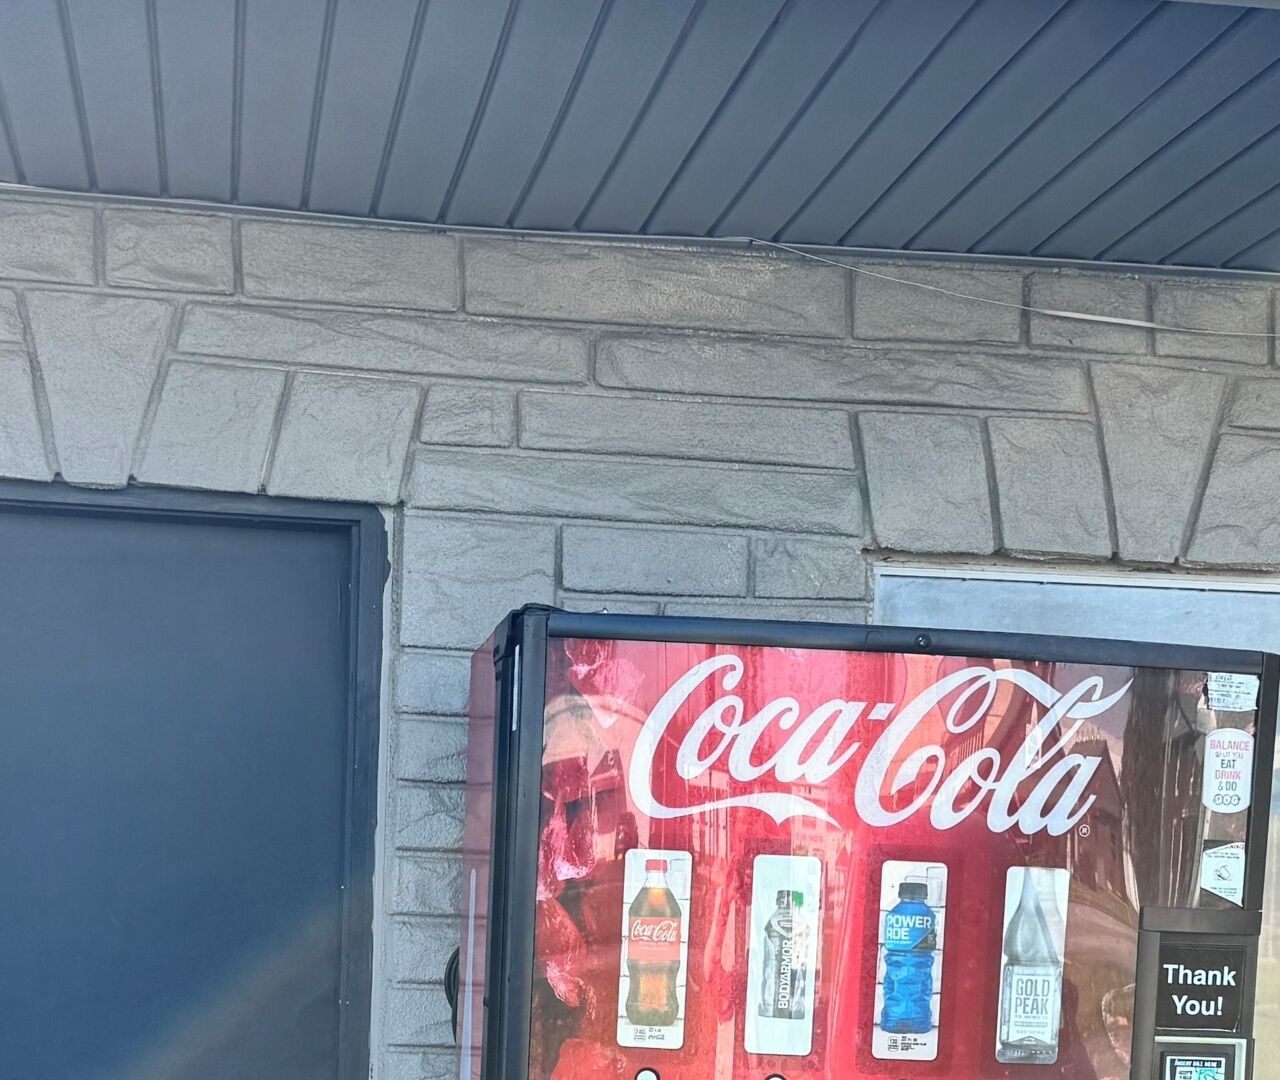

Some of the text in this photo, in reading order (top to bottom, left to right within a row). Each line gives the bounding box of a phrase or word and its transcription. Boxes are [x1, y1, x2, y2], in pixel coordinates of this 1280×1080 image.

[627, 653, 1135, 838] Coca-Cola
[1209, 739, 1250, 752] BALANCE
[1220, 759, 1237, 769] EAT
[1214, 770, 1241, 781] DRINK
[1225, 781, 1238, 792] DO
[631, 919, 678, 942] Coca-Cola
[886, 914, 932, 929] POWER
[886, 927, 910, 940] ADE
[777, 939, 794, 1009] BODYARMOR
[1162, 963, 1237, 987] Thank
[1015, 978, 1050, 998] GOLD
[1014, 997, 1049, 1015] PEAK
[1171, 995, 1223, 1017] You!
